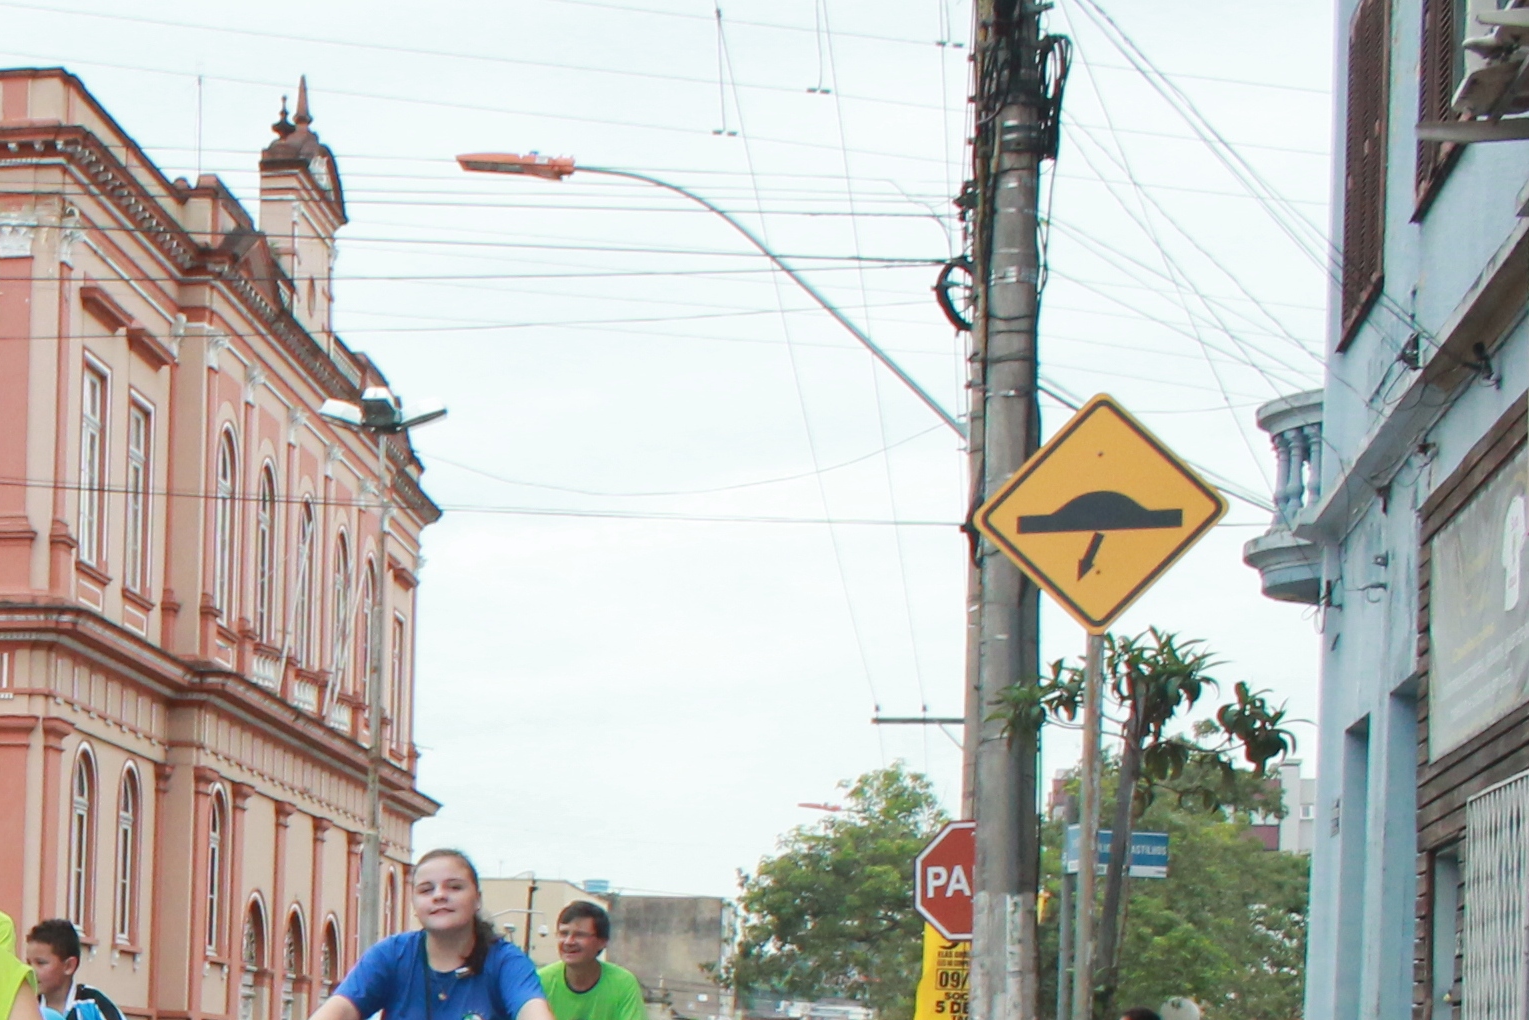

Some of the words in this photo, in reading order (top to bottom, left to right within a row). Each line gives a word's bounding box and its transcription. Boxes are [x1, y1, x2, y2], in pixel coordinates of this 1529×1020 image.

[1131, 845, 1167, 856] ASTILHOS
[926, 864, 975, 899] PA
[939, 971, 970, 990] 09/
[944, 992, 969, 1001] SOC
[935, 1001, 945, 1014] 5
